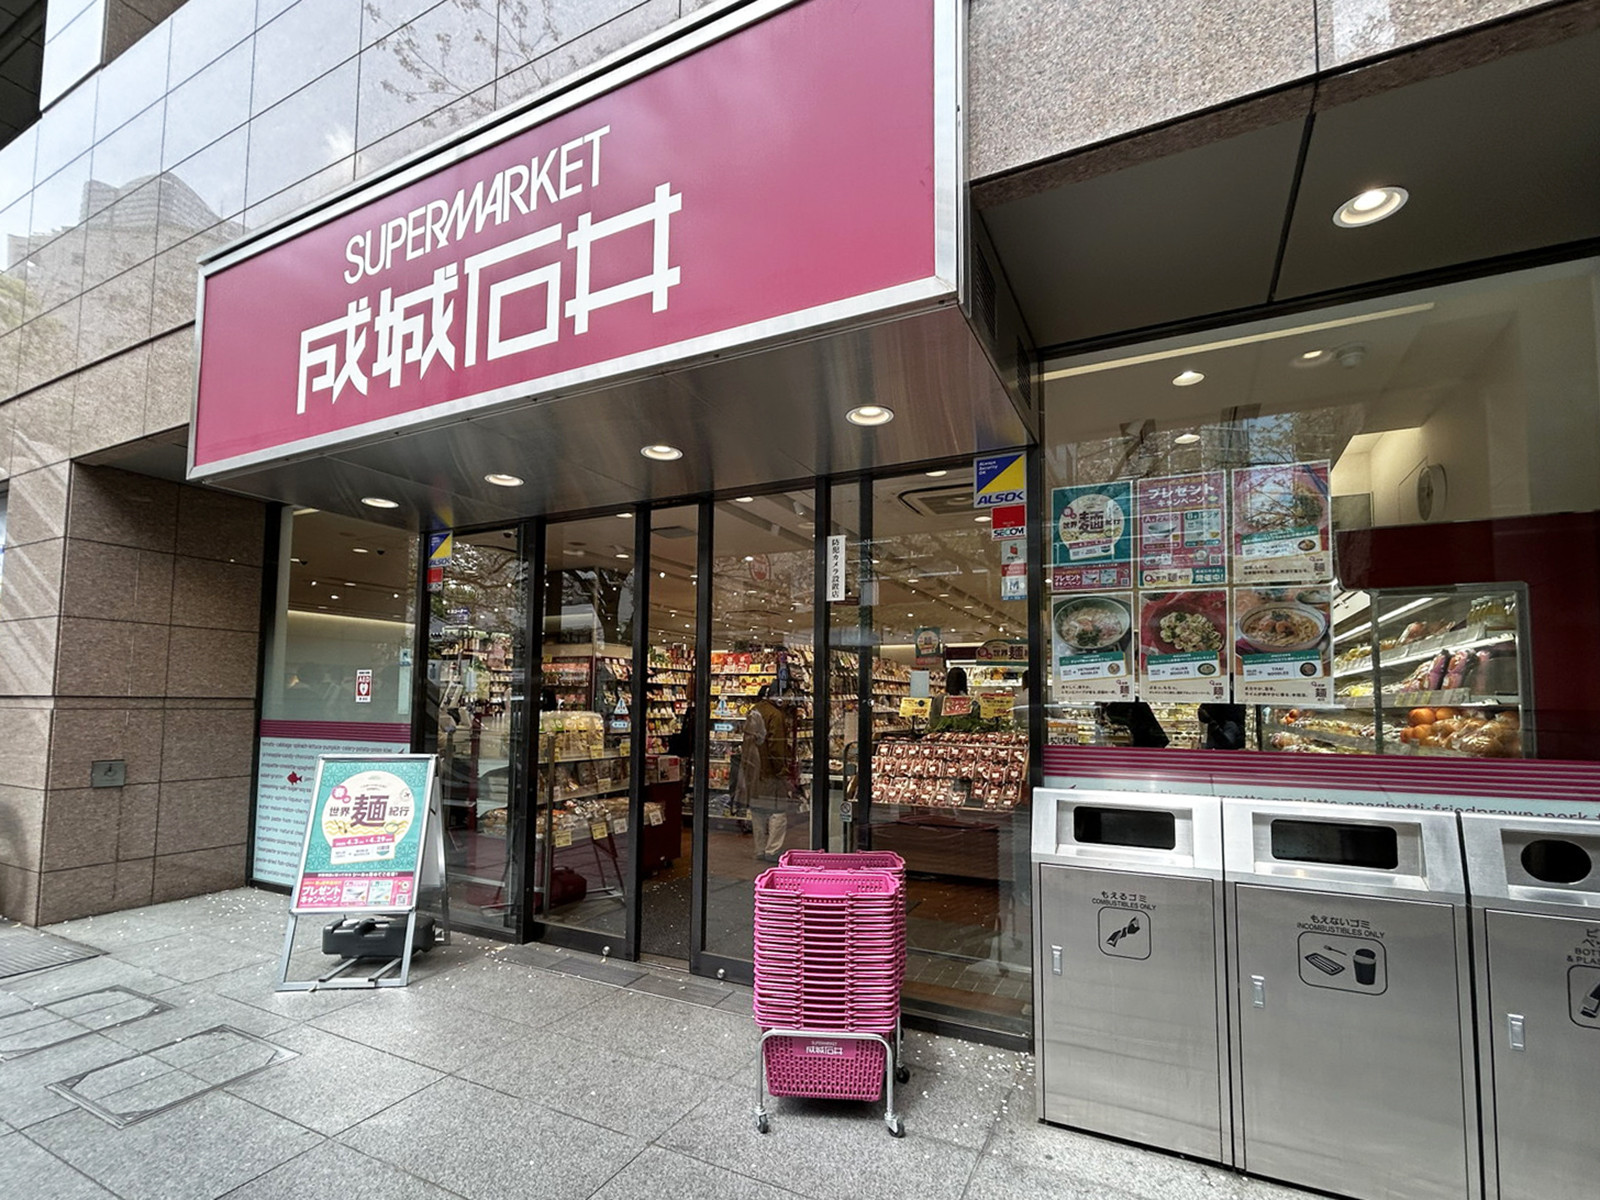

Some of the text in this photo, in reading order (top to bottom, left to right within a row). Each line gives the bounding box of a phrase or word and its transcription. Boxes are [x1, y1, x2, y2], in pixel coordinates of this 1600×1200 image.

[343, 125, 611, 284] SUPERMARKET
[295, 181, 683, 415] 成城石井
[977, 491, 1024, 505] ALSOK
[1148, 483, 1215, 500] プレゼント
[1157, 496, 1205, 507] キャンペーン
[993, 527, 1025, 537] SECOM
[329, 794, 410, 828] 世界麺紀行
[301, 885, 342, 896] プレゼント
[1101, 890, 1147, 903] もえるゴミ
[300, 895, 341, 904] キャンペーン
[1091, 897, 1157, 911] COMBUSTIBLES ONLY
[1310, 914, 1371, 930] もえないゴミ
[1296, 922, 1386, 939] INCOMBUSTIBLES ONLY
